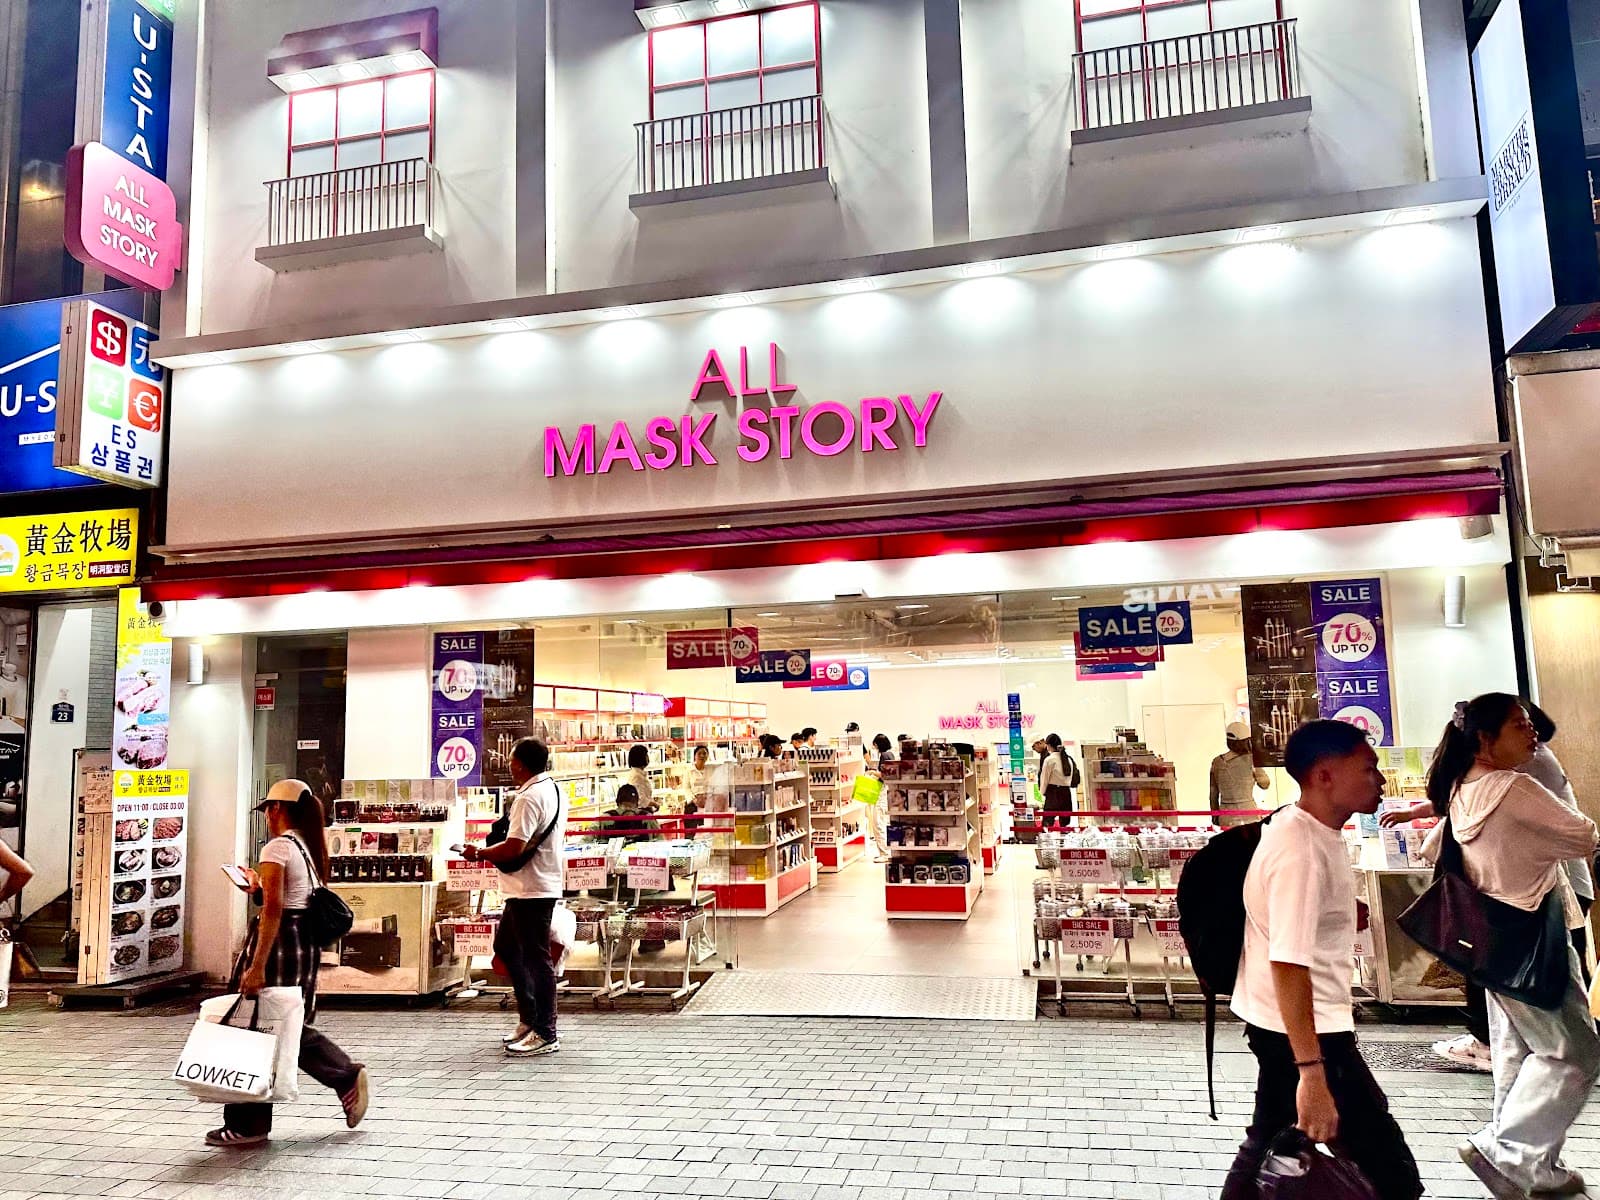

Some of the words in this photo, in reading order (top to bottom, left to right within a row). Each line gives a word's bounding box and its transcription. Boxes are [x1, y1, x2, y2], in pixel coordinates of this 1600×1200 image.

[125, 13, 157, 169] U-STA
[114, 175, 149, 208] ALL
[103, 195, 157, 240] MASK
[99, 226, 158, 268] STORY
[690, 342, 797, 400] ALL
[112, 424, 137, 449] ES
[543, 412, 718, 478] MASK
[736, 391, 943, 462] STORY
[91, 442, 153, 479] 상품권
[24, 561, 87, 584] 황금목장
[1321, 587, 1370, 602] SALE
[1086, 617, 1152, 637] SALE
[1159, 616, 1180, 626] 70%
[1329, 622, 1372, 643] 70%
[440, 639, 476, 650] SALE
[672, 639, 728, 658] SALE
[1331, 643, 1348, 654] UP
[1351, 643, 1369, 653] TO
[444, 685, 457, 694] UP
[1328, 679, 1379, 694] SALE
[57, 712, 68, 721] 23
[976, 701, 1002, 713] ALL
[439, 716, 475, 728] SALE
[939, 715, 983, 729] MASK
[443, 764, 456, 772] UP
[458, 763, 470, 771] TO
[117, 804, 132, 812] OPEN
[152, 802, 169, 811] CLOSE
[175, 1060, 260, 1091] LOWKET
